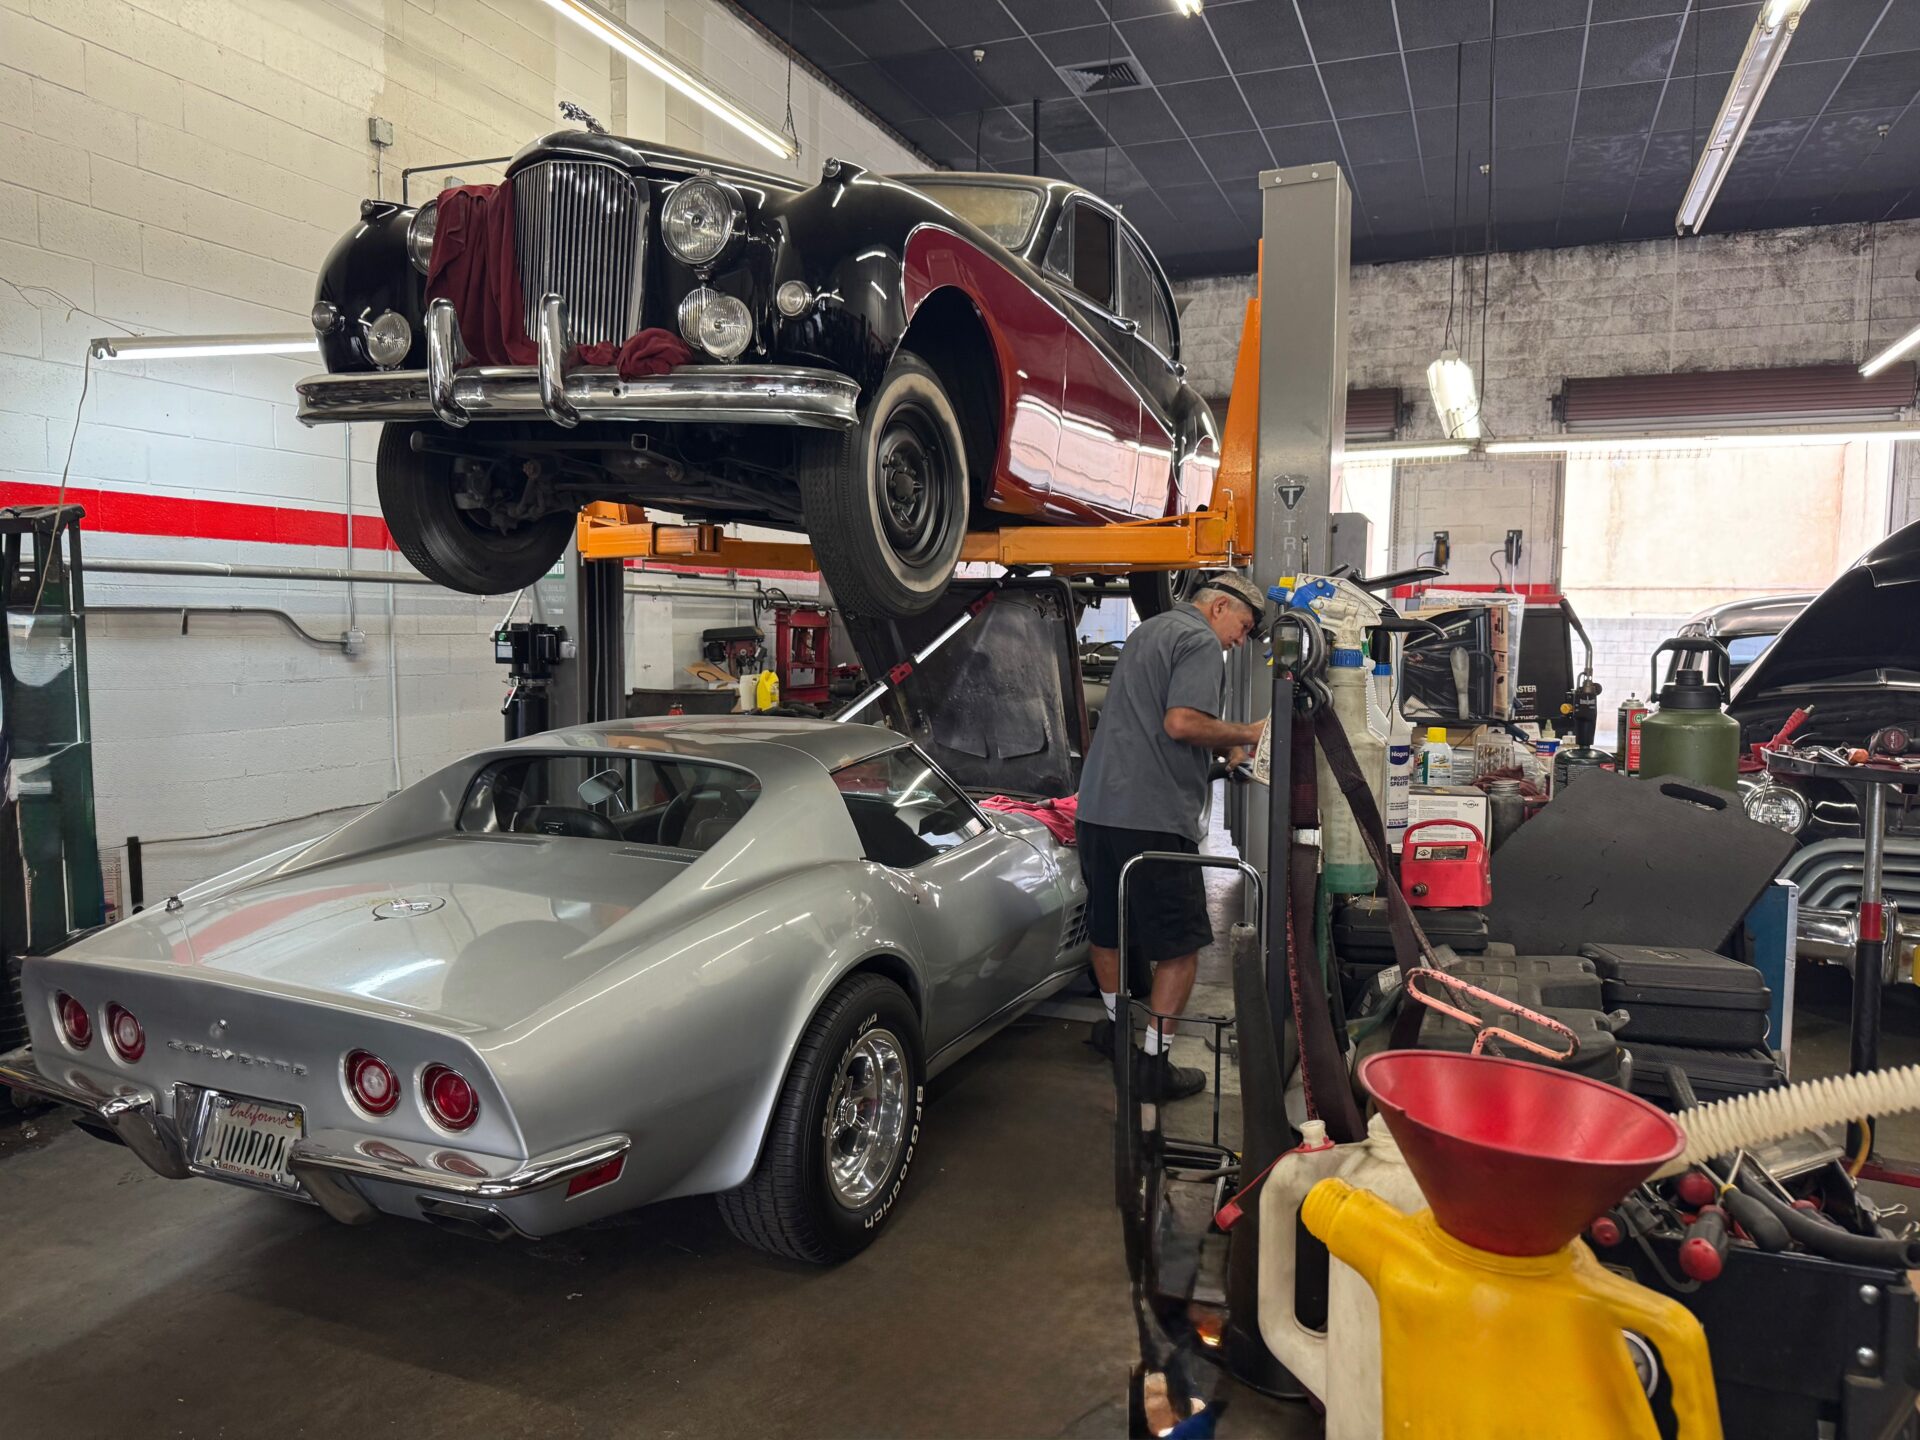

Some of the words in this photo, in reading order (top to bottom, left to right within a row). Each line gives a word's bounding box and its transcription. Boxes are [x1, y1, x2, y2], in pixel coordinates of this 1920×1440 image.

[1515, 685, 1537, 693] ASTER
[857, 1012, 879, 1036] T/A
[229, 1102, 294, 1129] California
[864, 1084, 925, 1231] BFGoodrich
